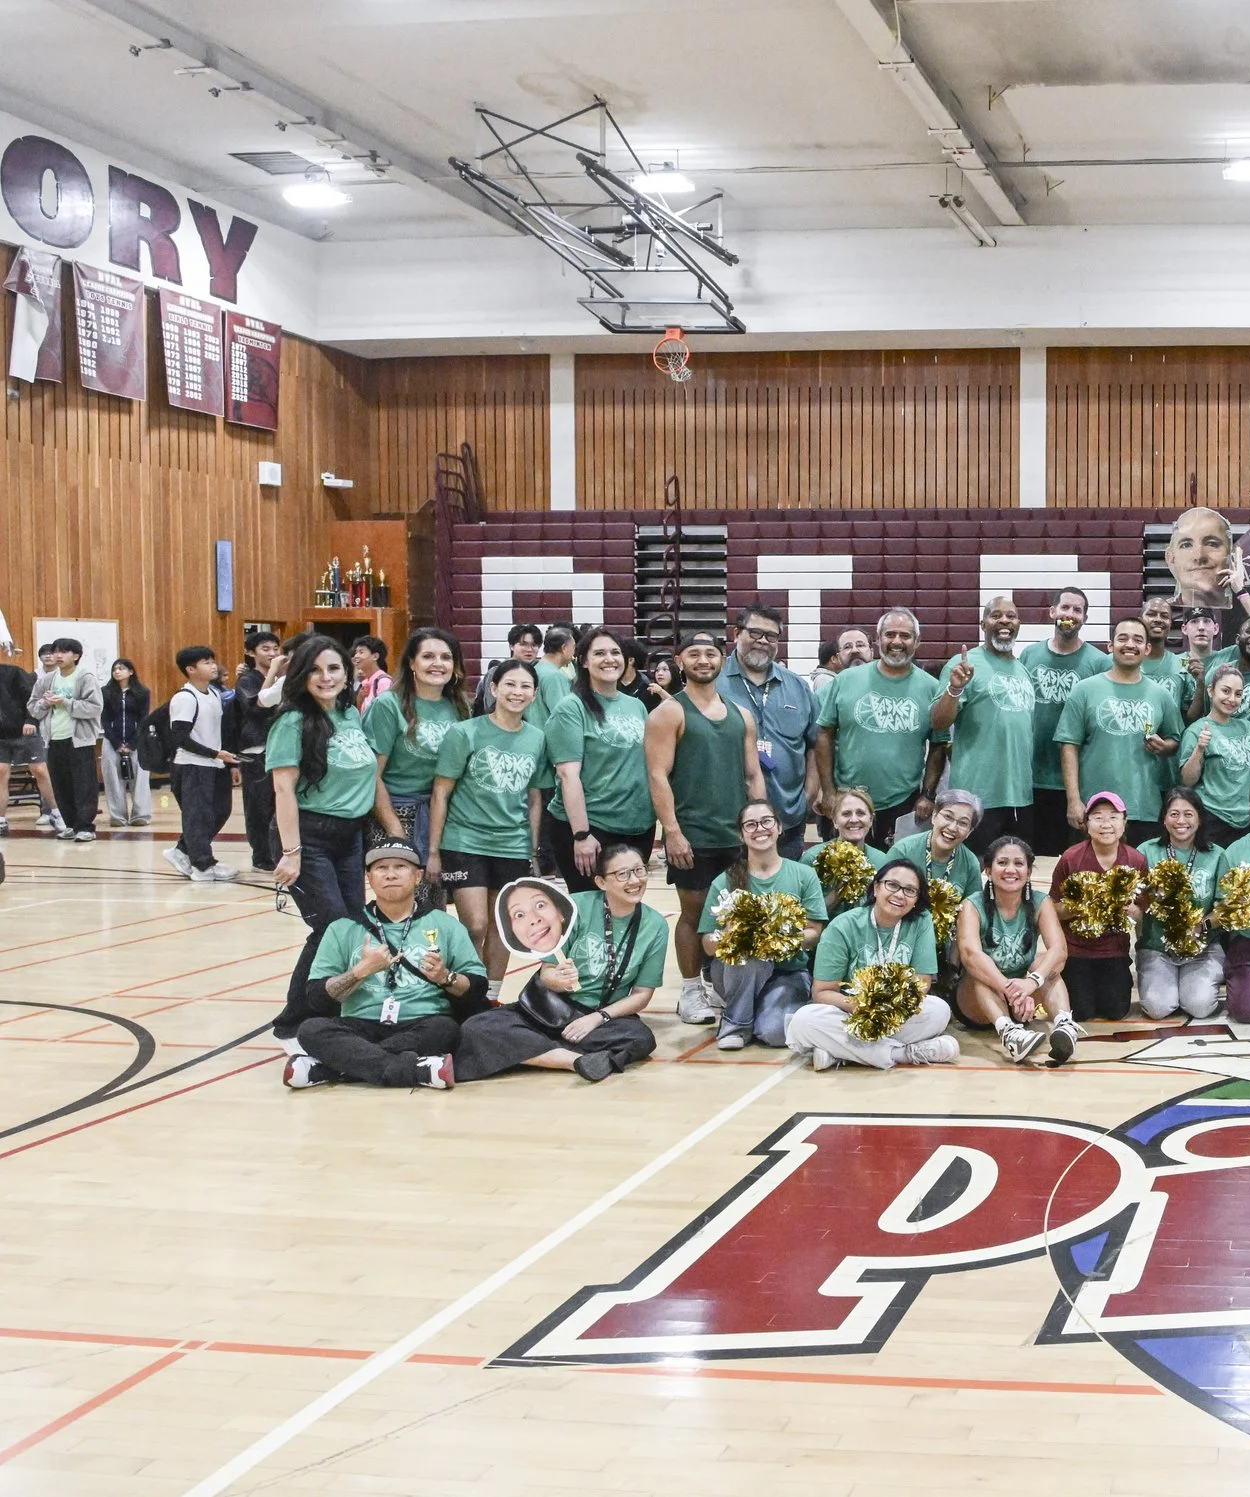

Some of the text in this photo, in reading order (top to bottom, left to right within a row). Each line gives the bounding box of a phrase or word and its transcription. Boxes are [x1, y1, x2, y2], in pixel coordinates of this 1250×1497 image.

[1, 135, 258, 304] ORY
[106, 296, 133, 310] TENNIS
[868, 692, 920, 720] BASKET
[1041, 685, 1072, 703] BRAW
[876, 711, 921, 732] BRAWL
[1108, 696, 1153, 726] BASKET
[1115, 713, 1150, 733] BRAW
[485, 746, 537, 776] BASKET
